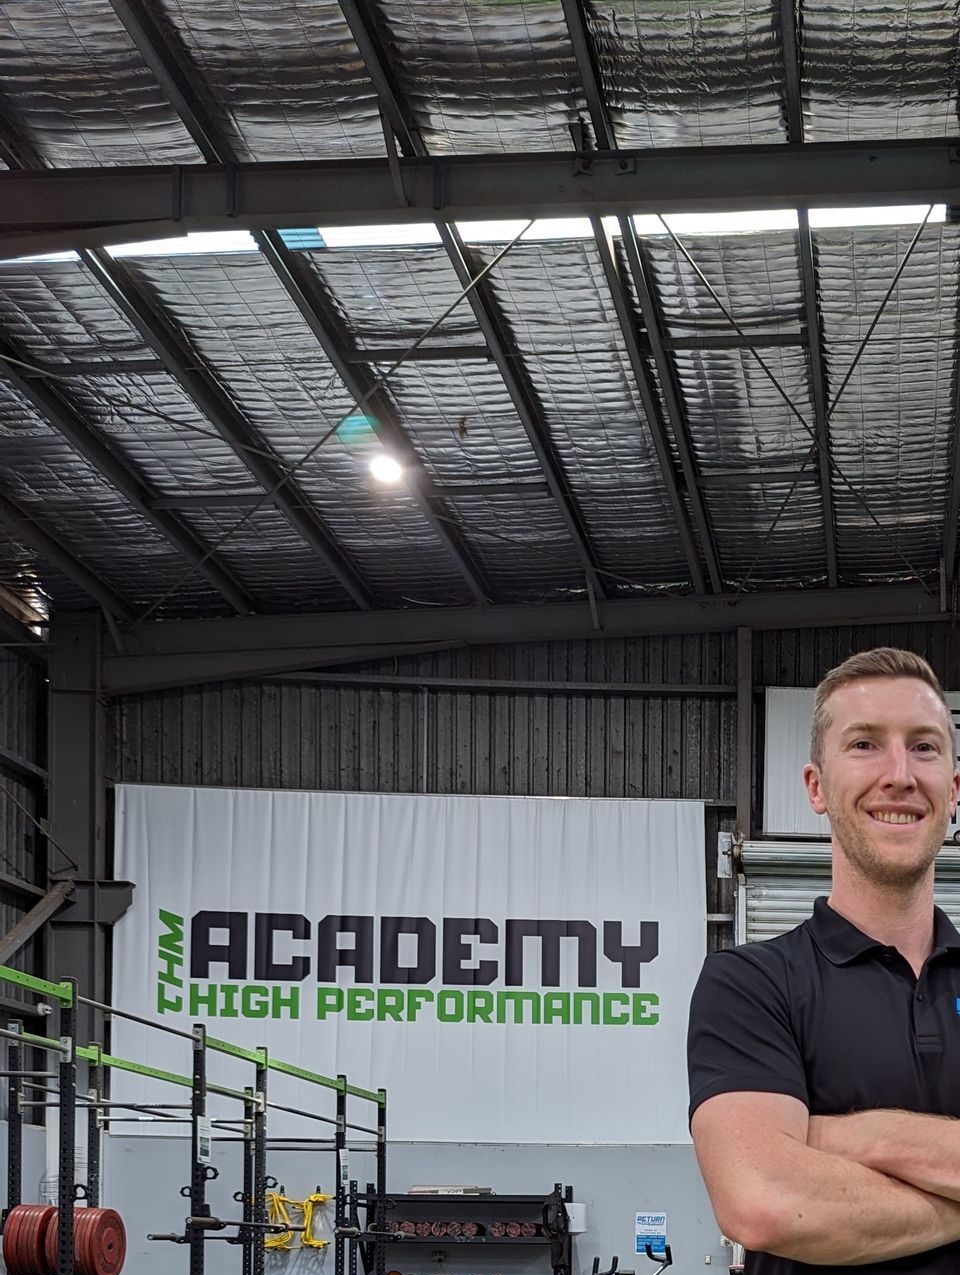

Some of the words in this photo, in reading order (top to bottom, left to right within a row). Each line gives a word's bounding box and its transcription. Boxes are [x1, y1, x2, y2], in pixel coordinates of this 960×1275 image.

[189, 910, 659, 988] ACADEMY
[189, 984, 299, 1018] HIGH
[317, 987, 659, 1025] PERFORMANCE
